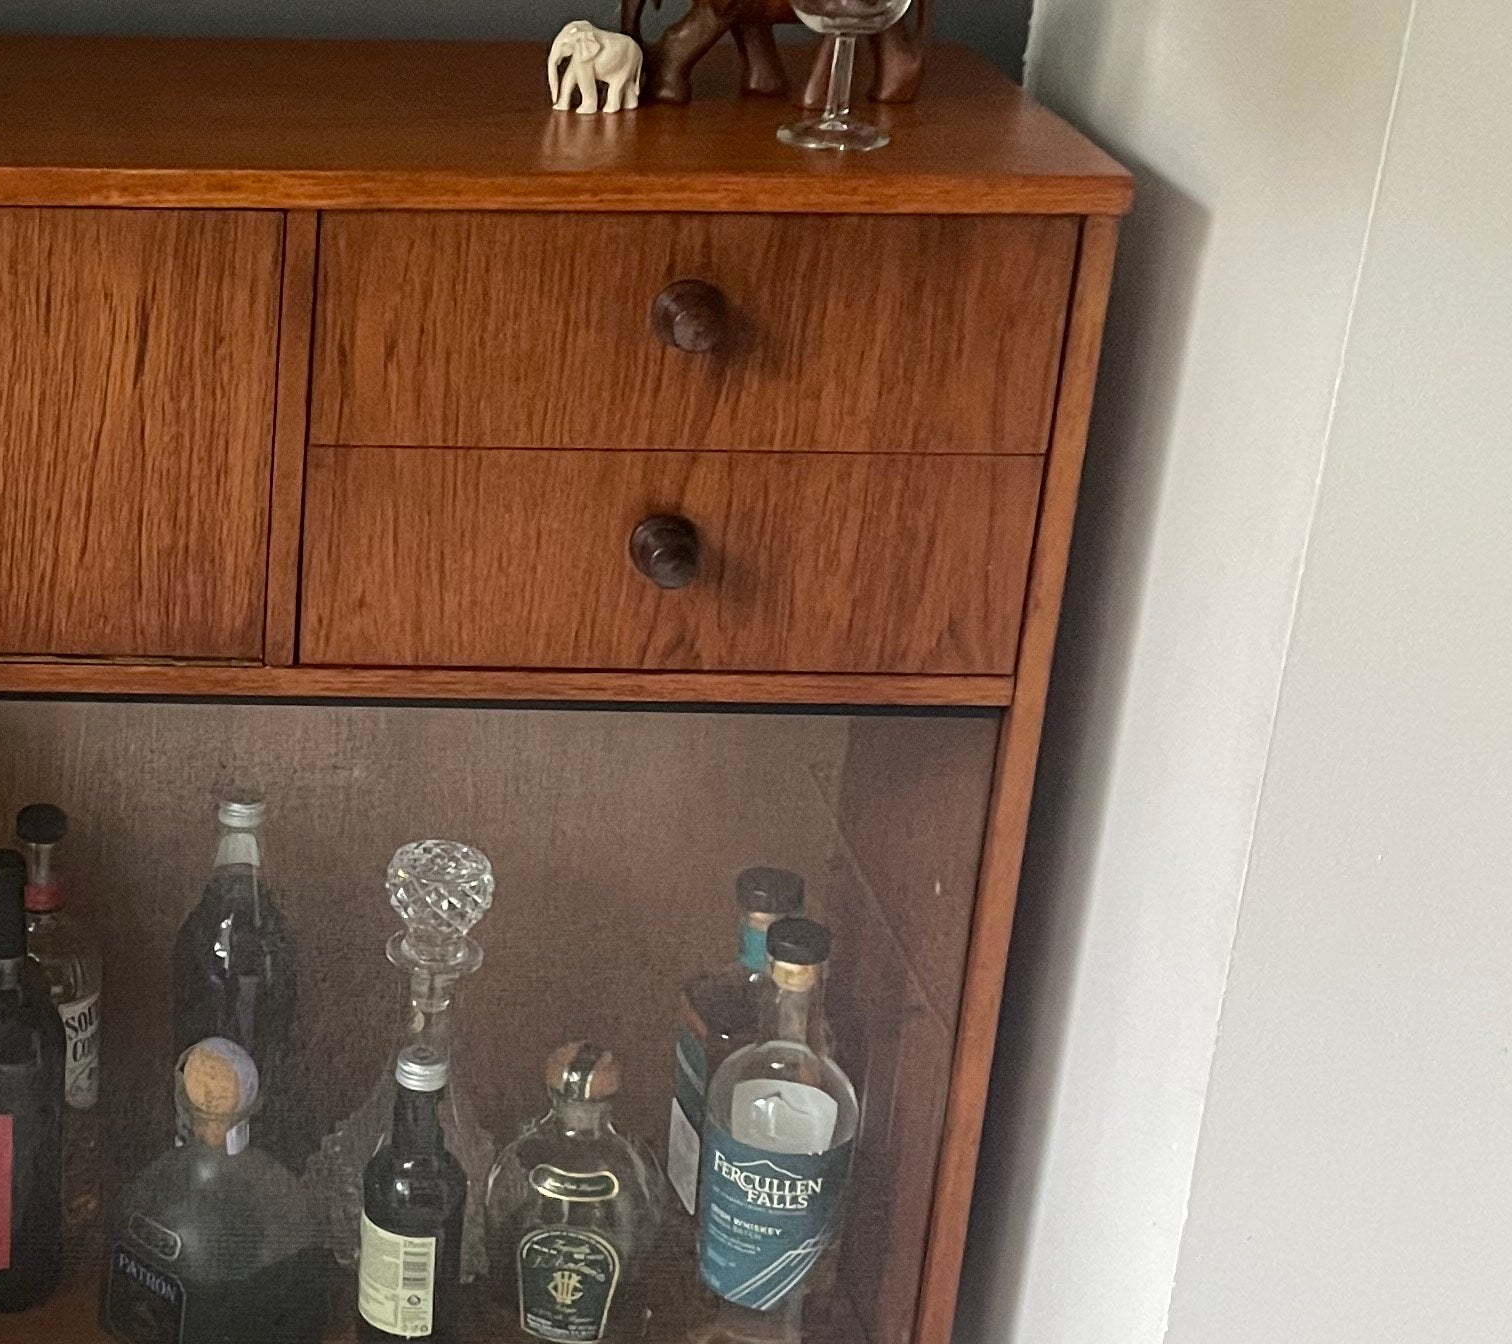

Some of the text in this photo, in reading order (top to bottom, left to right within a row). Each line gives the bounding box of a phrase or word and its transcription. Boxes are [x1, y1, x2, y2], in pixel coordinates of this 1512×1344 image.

[713, 1149, 823, 1194] FERCULLEN
[746, 1189, 810, 1210] FALLS
[733, 1216, 782, 1236] WHISKEY
